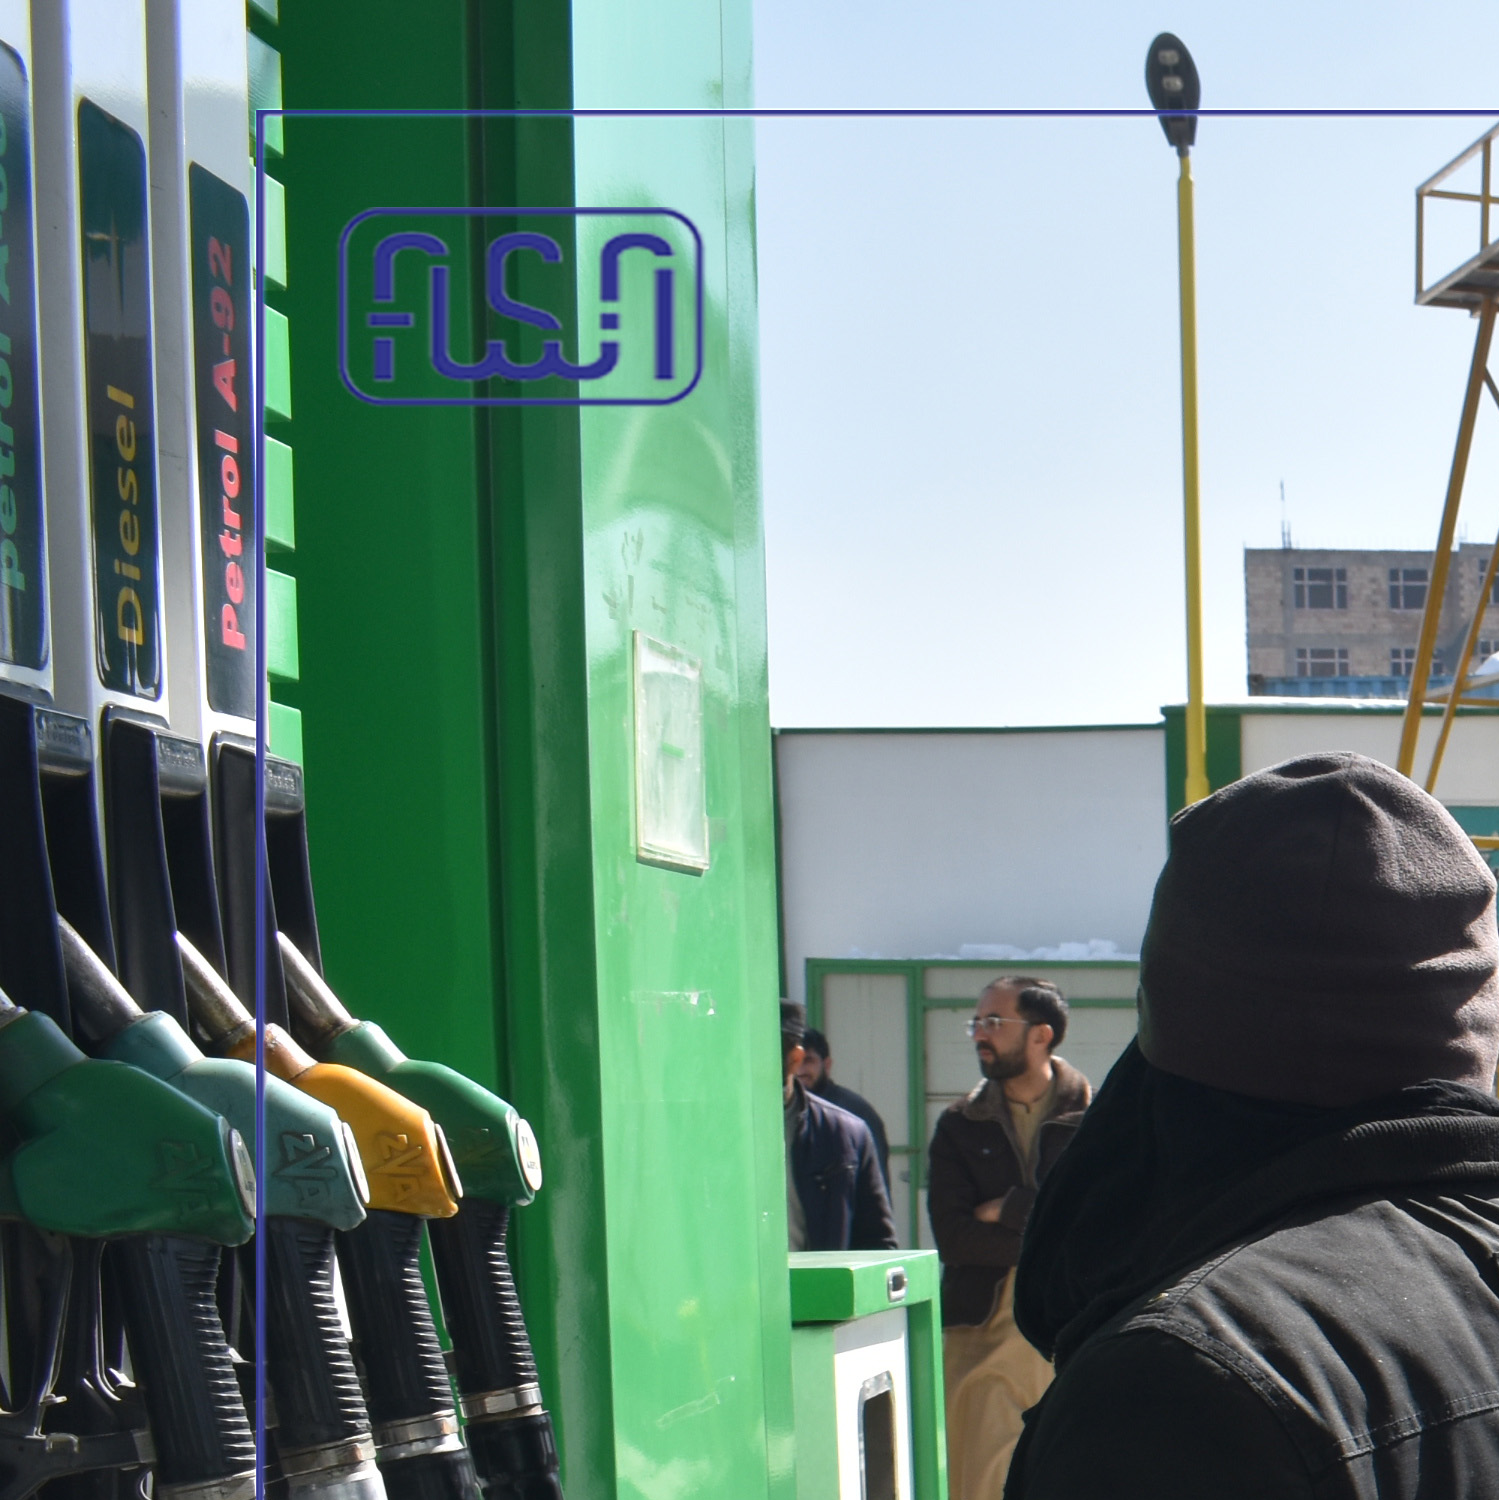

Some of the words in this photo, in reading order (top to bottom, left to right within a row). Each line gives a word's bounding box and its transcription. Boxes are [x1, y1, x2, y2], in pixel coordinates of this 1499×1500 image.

[207, 236, 238, 412] A-92
[106, 384, 144, 646] Diesel
[213, 430, 246, 650] Petrol
